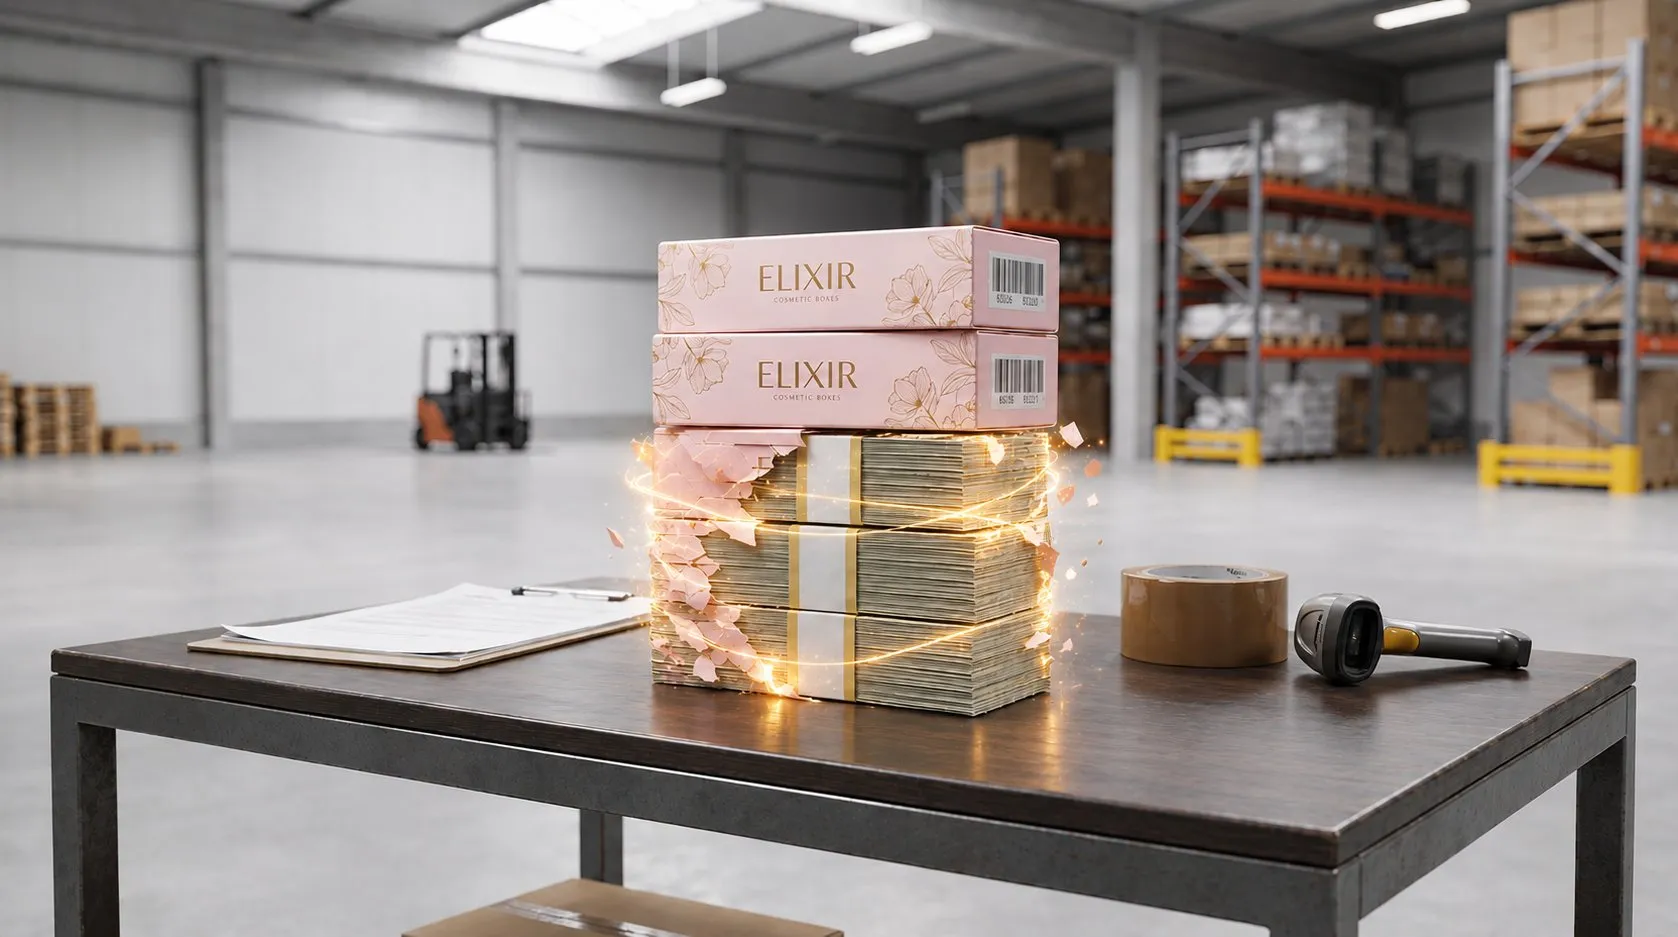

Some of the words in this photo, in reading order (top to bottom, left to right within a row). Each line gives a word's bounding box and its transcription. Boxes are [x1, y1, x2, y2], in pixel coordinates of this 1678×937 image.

[759, 261, 856, 292] ELIXIR
[773, 296, 812, 304] COSMETIC
[758, 361, 858, 389] ELIXIR
